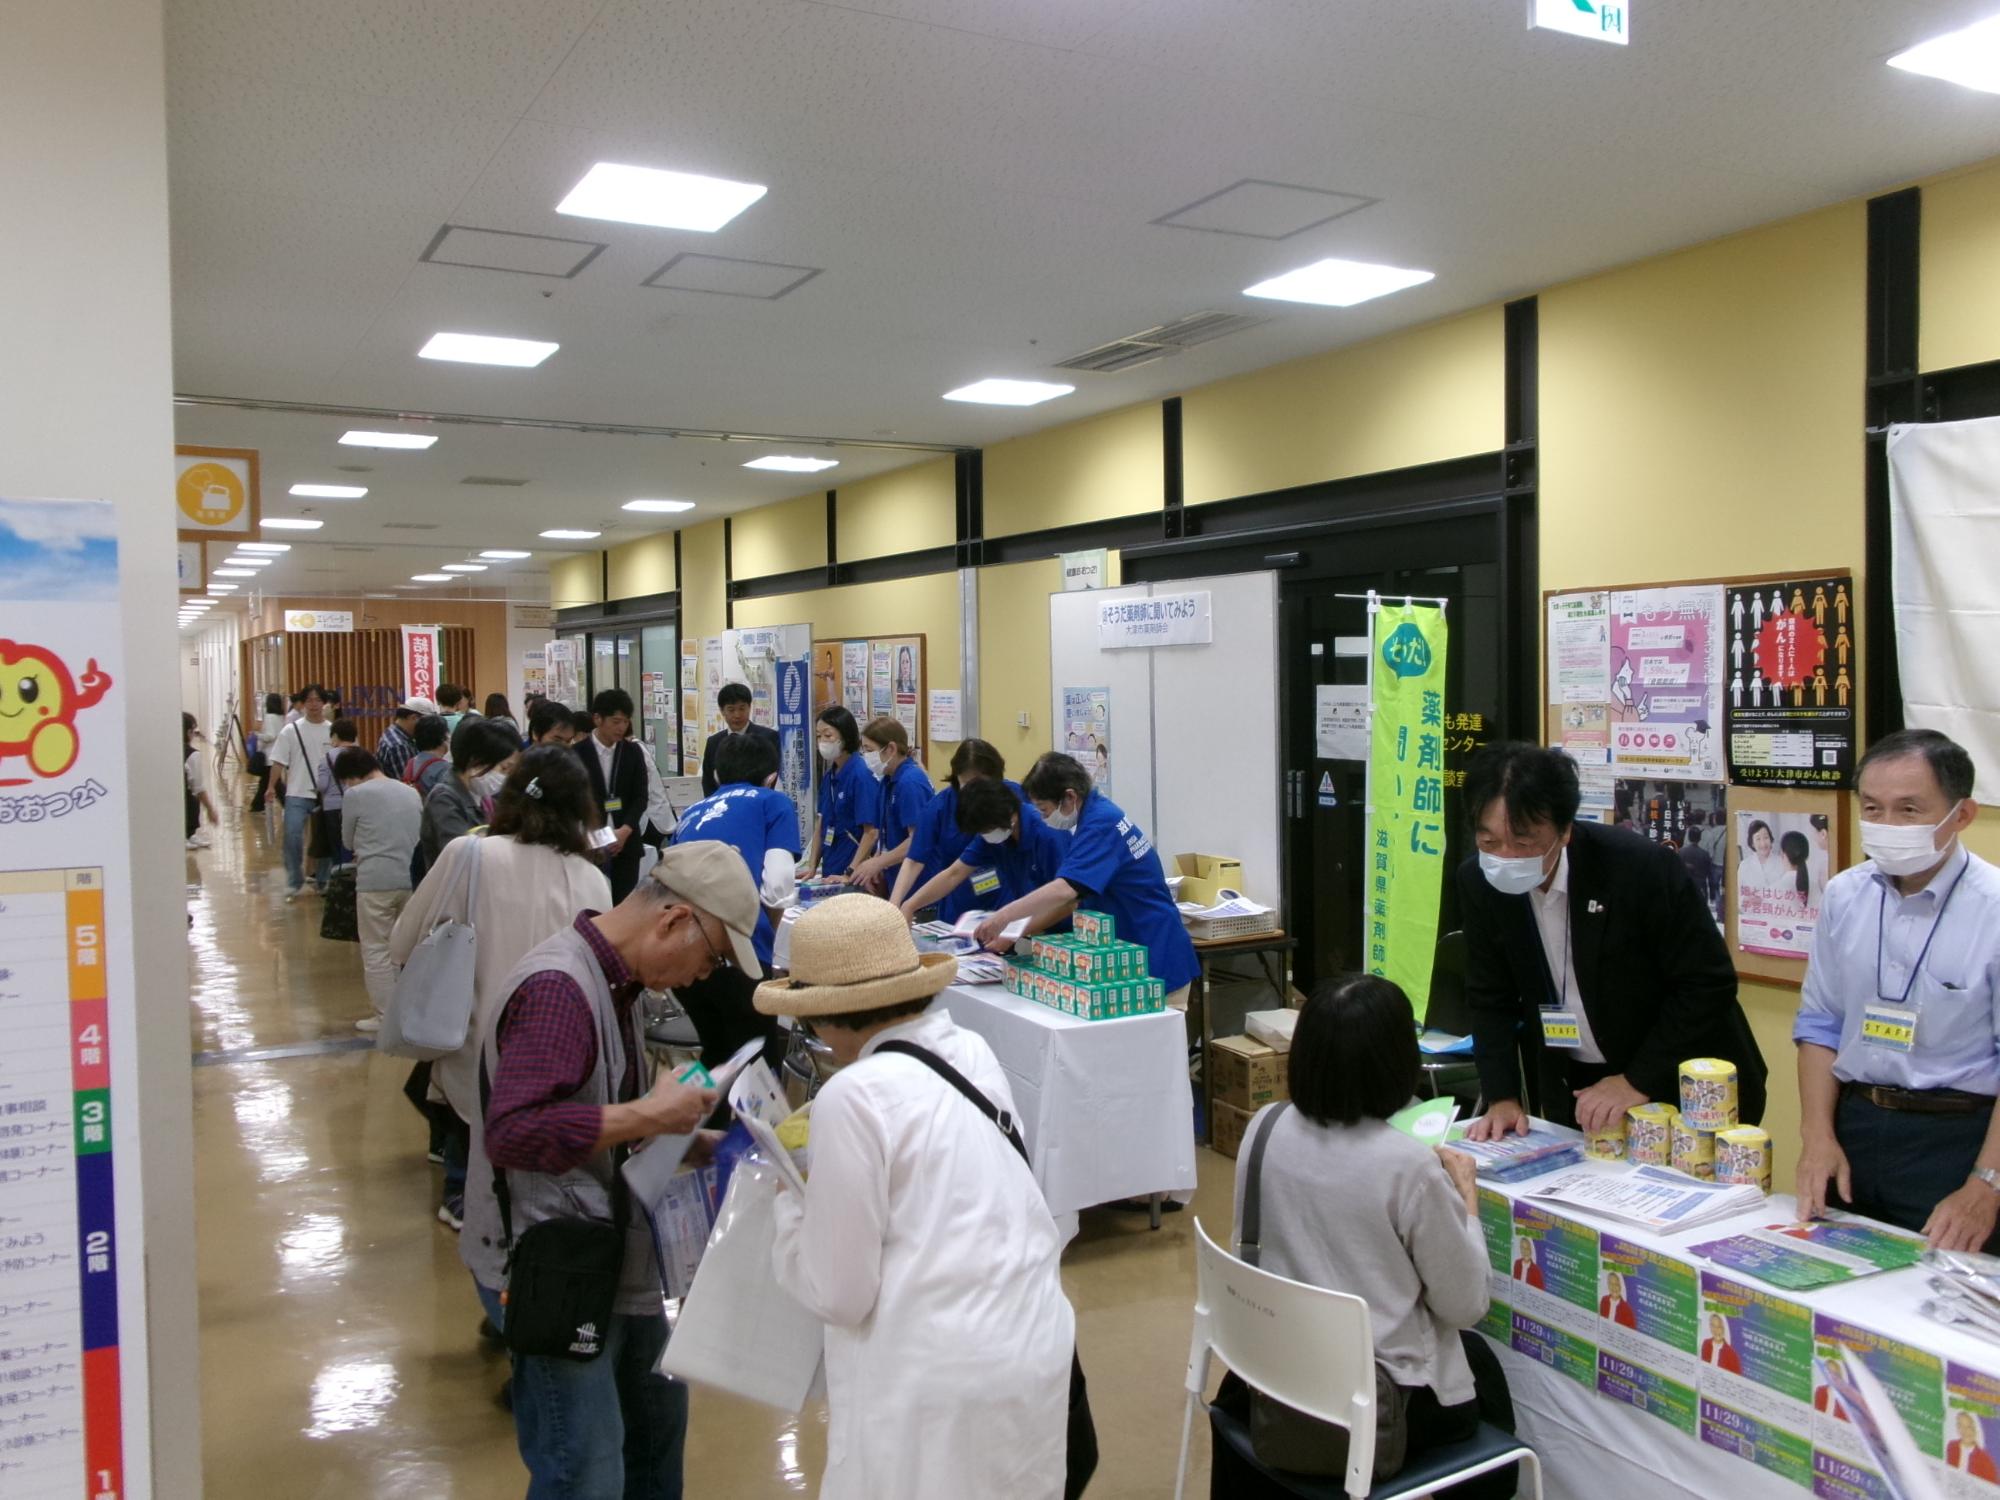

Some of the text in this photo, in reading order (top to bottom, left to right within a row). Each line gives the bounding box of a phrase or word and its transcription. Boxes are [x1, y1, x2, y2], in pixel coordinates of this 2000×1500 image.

[1411, 689, 1441, 856] 薬剤師に
[1864, 1023, 1912, 1039] STAFF
